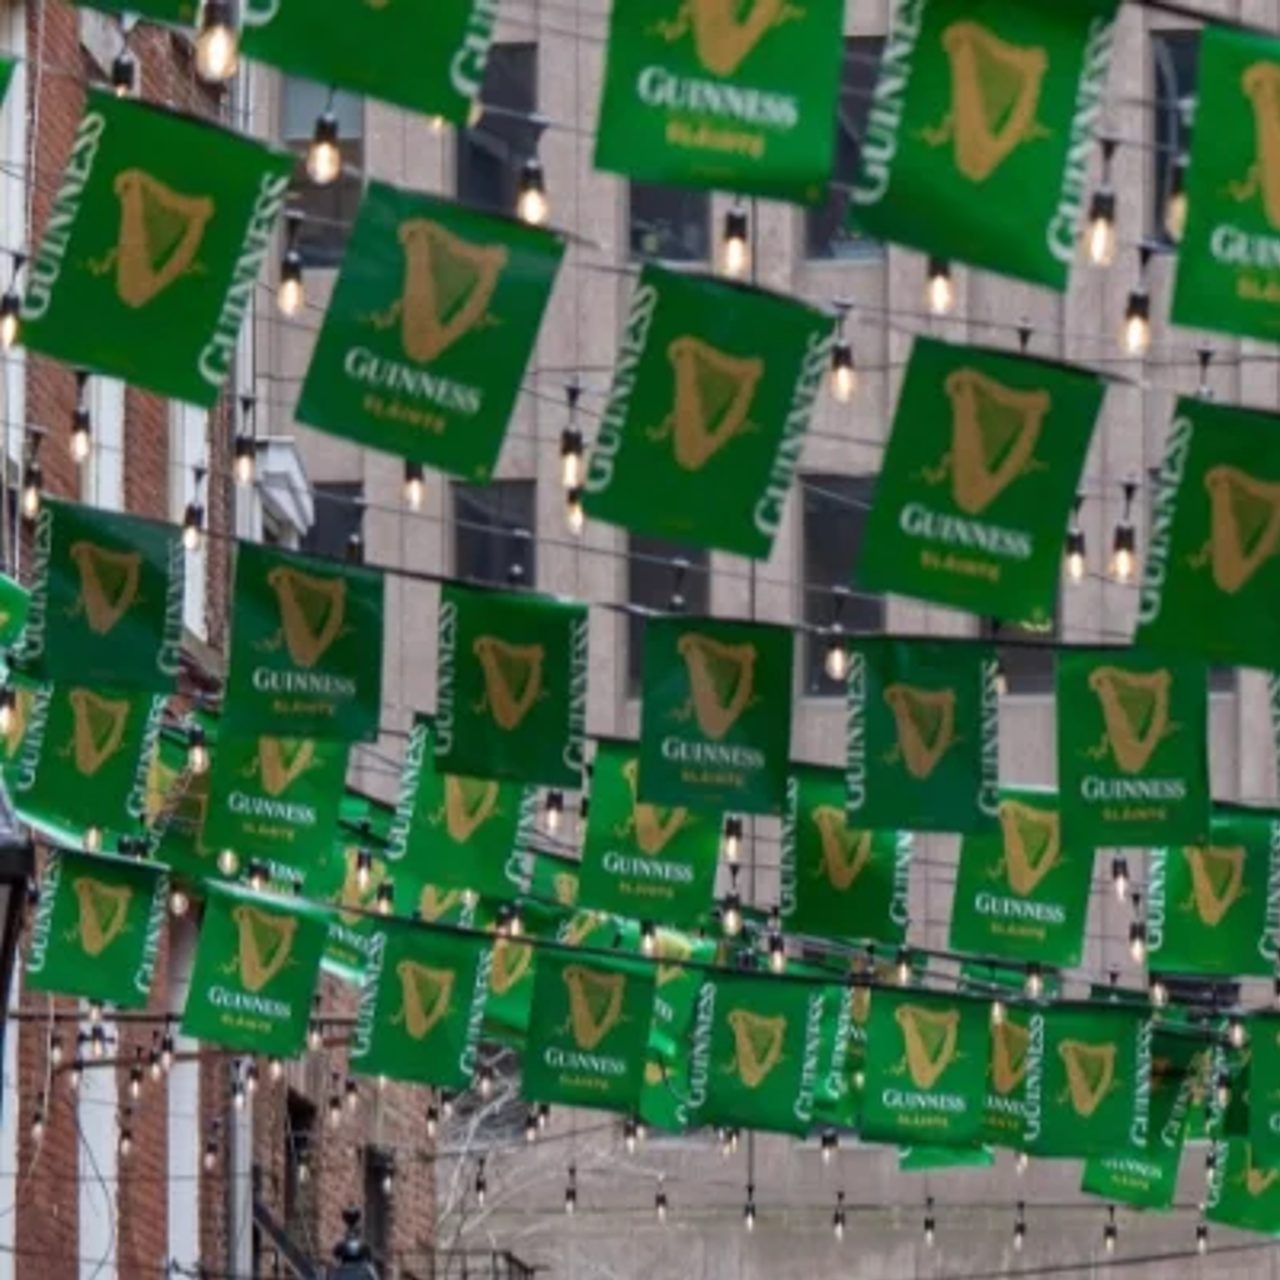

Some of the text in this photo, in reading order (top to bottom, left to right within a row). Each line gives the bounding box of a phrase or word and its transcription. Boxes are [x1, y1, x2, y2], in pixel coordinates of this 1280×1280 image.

[636, 65, 798, 128] GUINNESS
[1045, 18, 1115, 262] GUINNESS
[20, 112, 105, 320] GUINNESS
[198, 172, 290, 386] GUINNESS
[344, 345, 484, 415] GUINNESS
[586, 286, 658, 493] GUINNESS
[754, 332, 834, 537] GUINNESS
[900, 503, 1034, 559] GUINNESS
[1139, 416, 1193, 625] GUINNESS
[17, 682, 53, 792] GUINNE
[253, 666, 356, 697] GUINNESS
[435, 601, 457, 755] GUINNESS
[563, 616, 590, 771] GUINNESS
[845, 652, 866, 810] GUINNESS
[977, 659, 999, 817] GUINNESS
[126, 694, 169, 817] GUINNESS
[228, 790, 316, 825] GUINNESS
[384, 722, 428, 860] GUINNESS
[661, 735, 766, 769] GUINNESS
[1081, 776, 1187, 799] GUINNESS
[603, 850, 694, 883] GUINNESS
[975, 893, 1066, 923] GUINNESS
[208, 986, 291, 1016] GUINNESS
[351, 931, 387, 1058] GUINNESS
[689, 982, 716, 1107] GUINNESS
[544, 1047, 626, 1074] GUINNESS
[882, 1090, 966, 1112] GUINNESS
[1024, 1015, 1044, 1141] GUINNESS
[1131, 1020, 1152, 1146] GUINNESS
